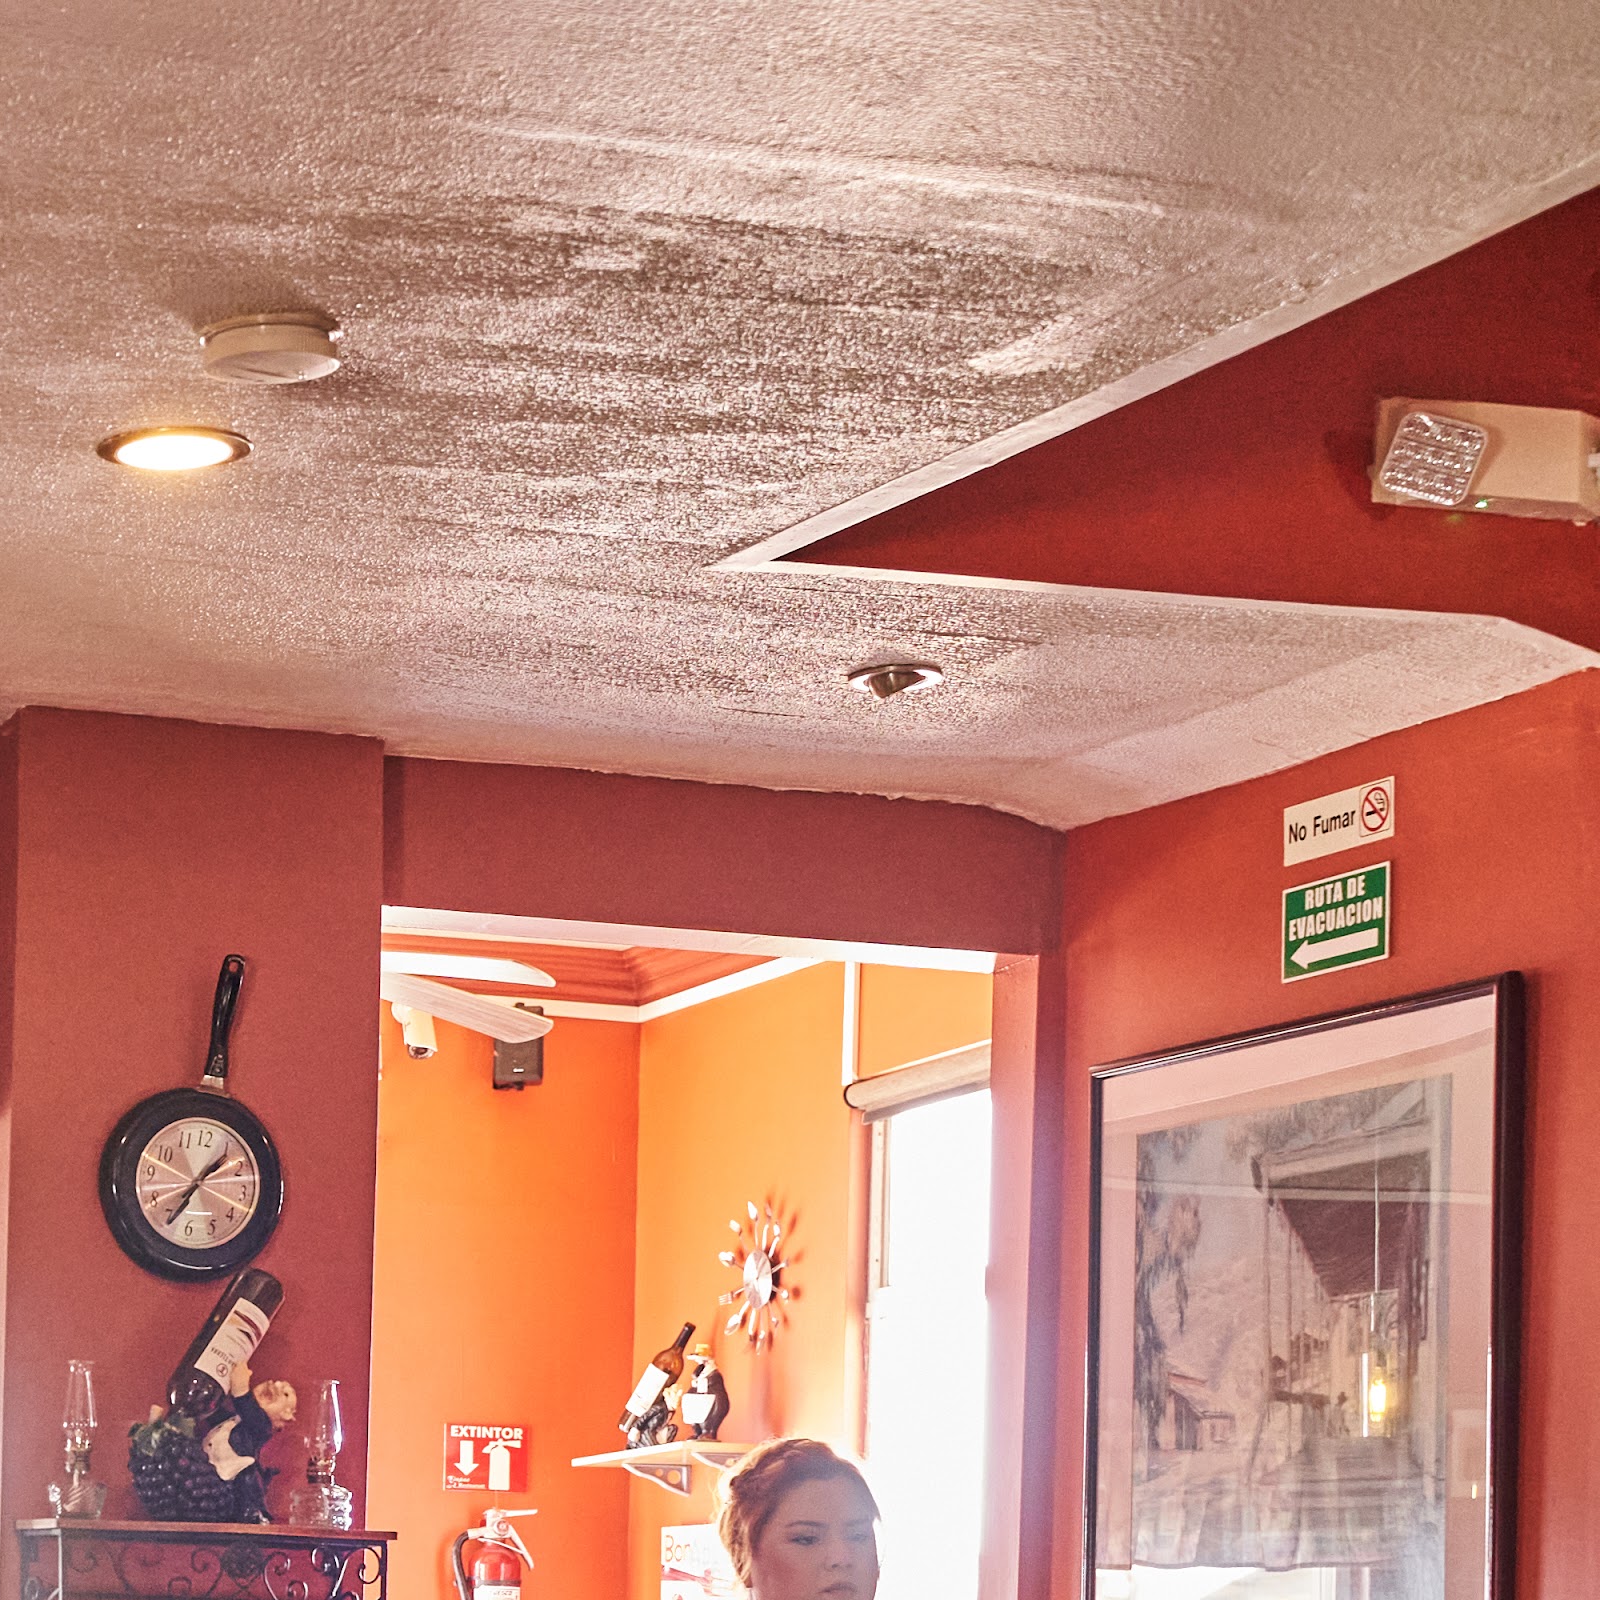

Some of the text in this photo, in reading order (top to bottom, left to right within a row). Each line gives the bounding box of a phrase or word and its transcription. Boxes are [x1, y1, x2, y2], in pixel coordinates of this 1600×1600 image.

[1288, 810, 1356, 844] No Fumar
[1304, 874, 1366, 911] RUTA DE
[1288, 896, 1384, 941] EVACUACION
[178, 1131, 192, 1149] 11
[197, 1130, 213, 1148] 12
[157, 1145, 173, 1162] 10
[147, 1165, 156, 1181] 9
[234, 1160, 243, 1177] 2
[151, 1191, 159, 1208] 8
[239, 1185, 247, 1202] 3
[225, 1206, 235, 1222] 4
[184, 1220, 193, 1237] 6
[207, 1219, 216, 1236] 5
[450, 1424, 524, 1440] EXTINTOR
